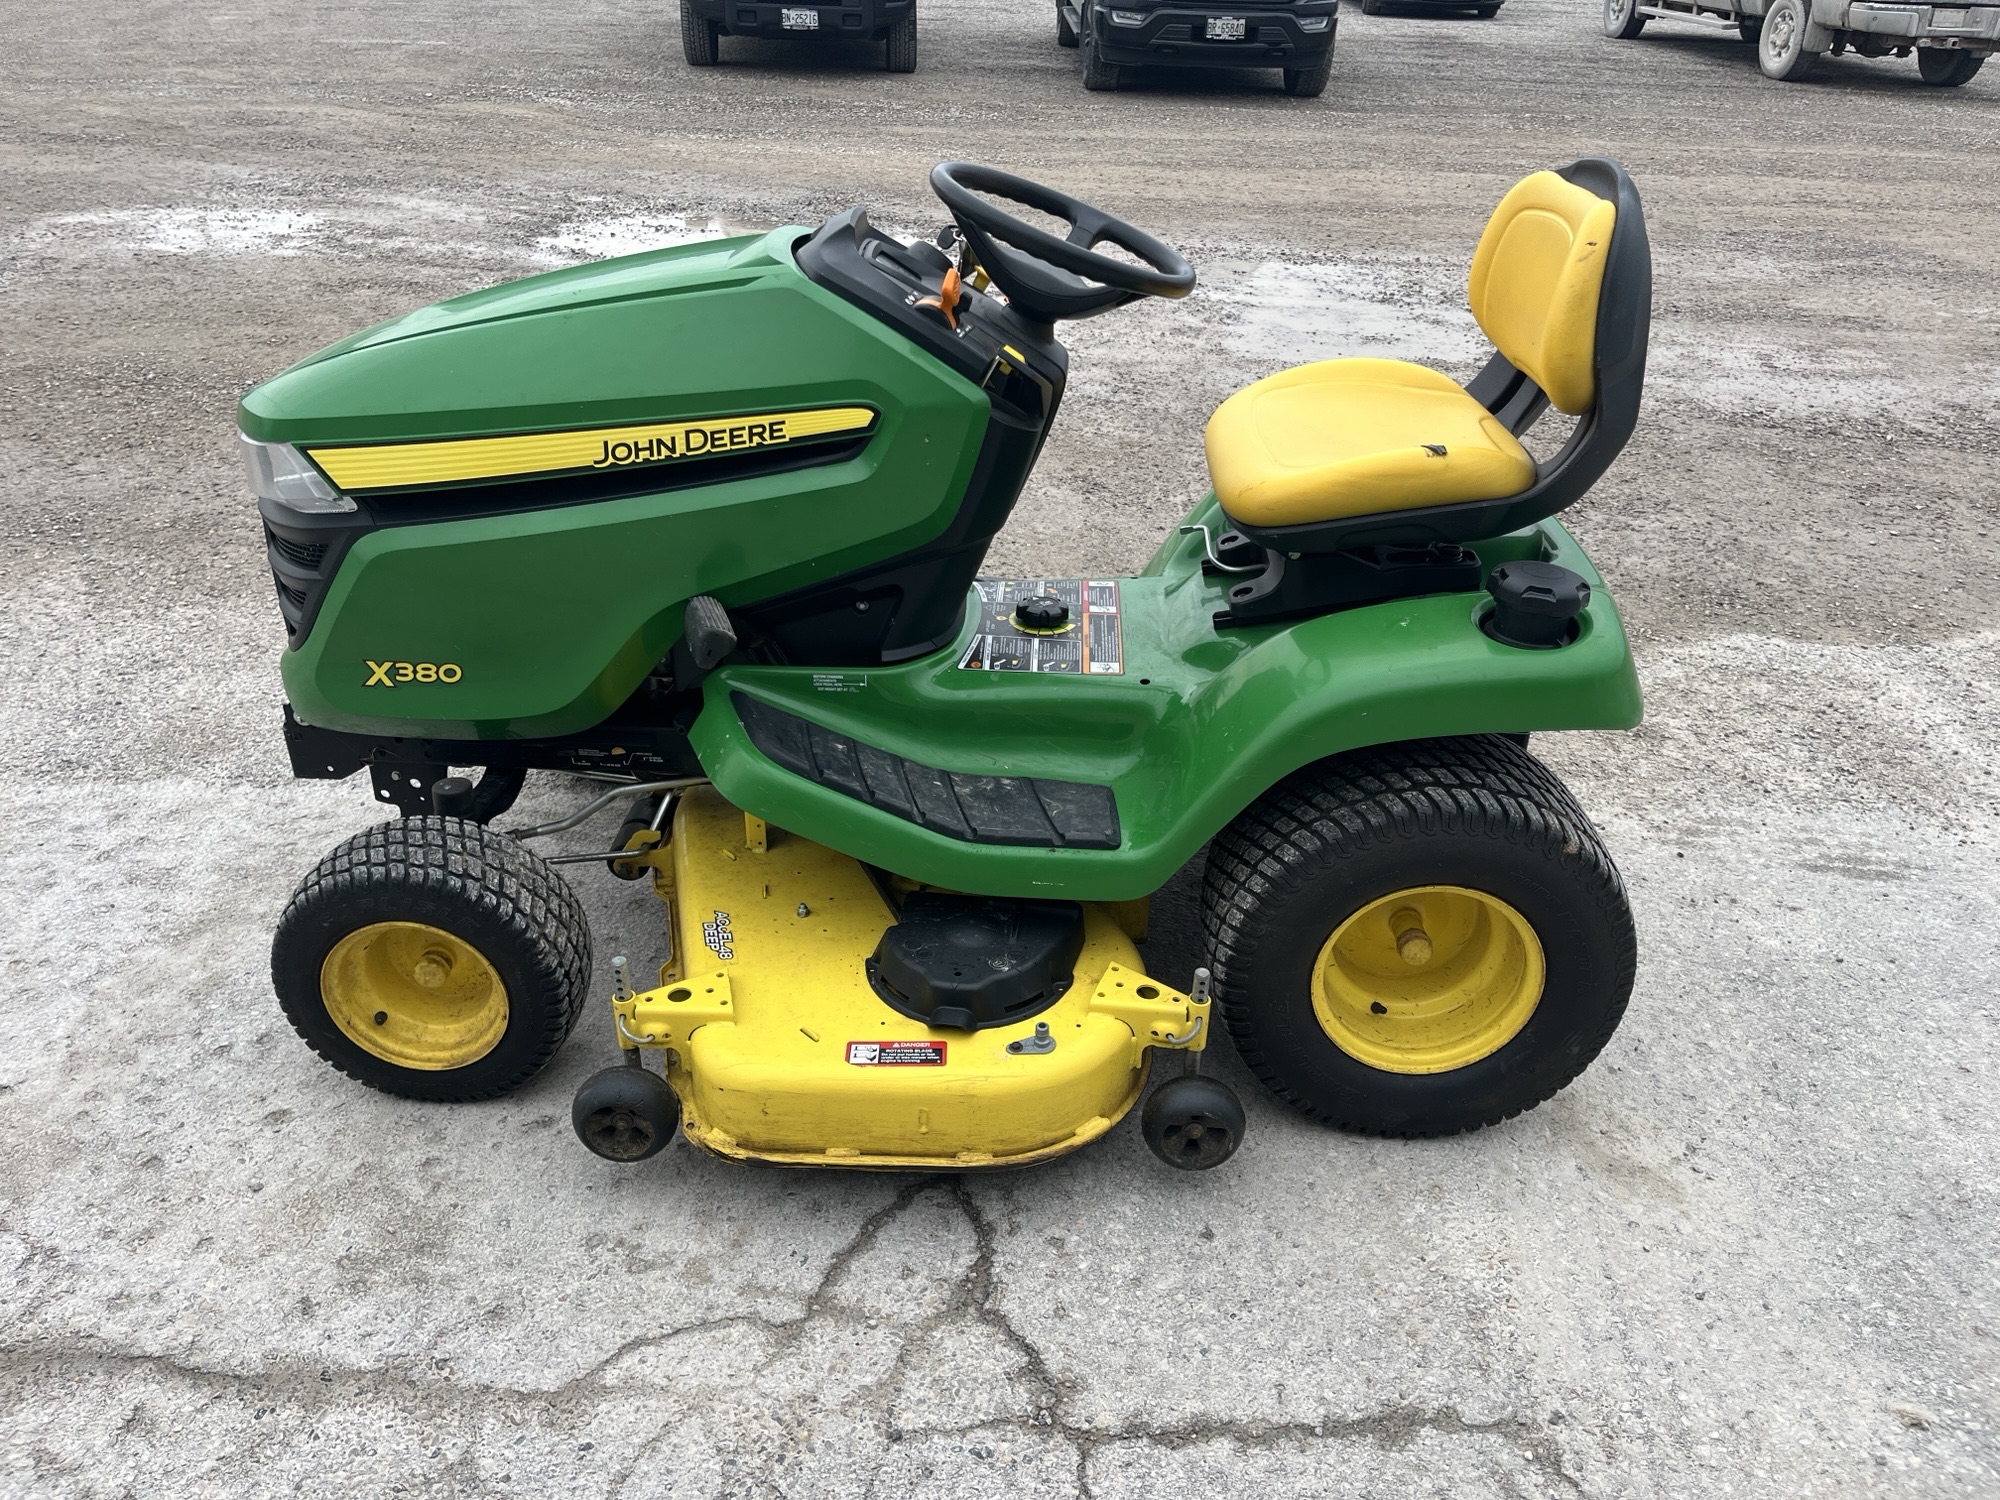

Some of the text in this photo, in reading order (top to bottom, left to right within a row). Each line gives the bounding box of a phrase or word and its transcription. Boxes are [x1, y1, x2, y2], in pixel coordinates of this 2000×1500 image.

[593, 420, 788, 466] JOHN DEERE
[363, 659, 463, 688] X380
[702, 922, 720, 952] DEEP
